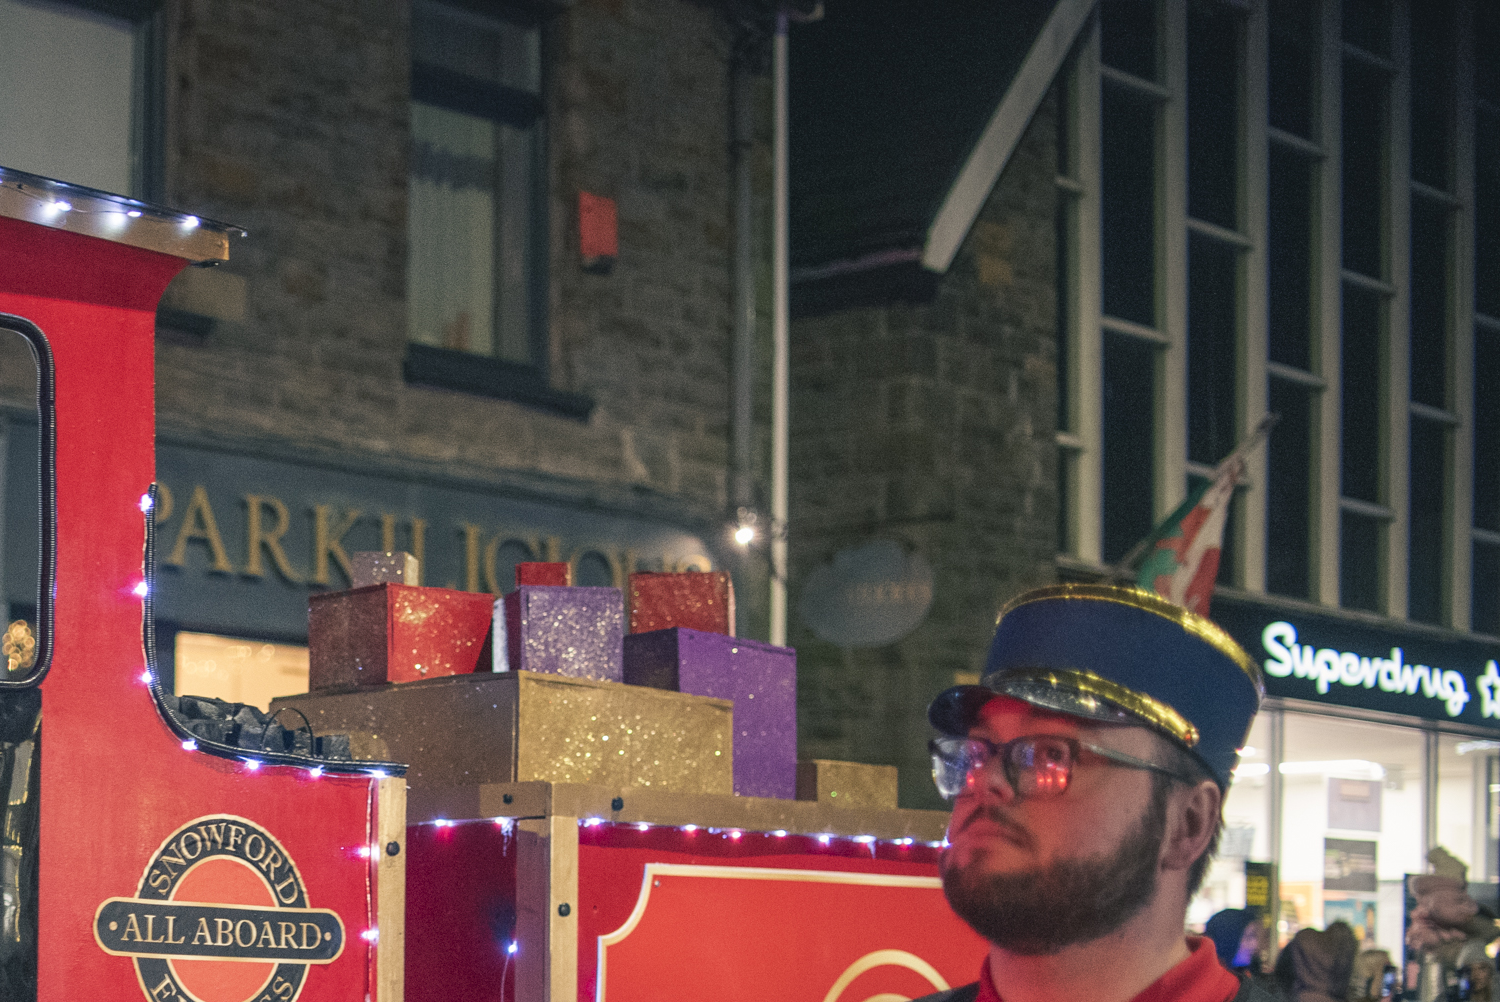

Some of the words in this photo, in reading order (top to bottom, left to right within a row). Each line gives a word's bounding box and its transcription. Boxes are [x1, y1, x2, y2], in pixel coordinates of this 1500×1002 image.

[1261, 621, 1471, 717] Superdrug
[150, 822, 299, 905] SNOWFORD
[121, 913, 185, 944] ALL
[191, 917, 322, 949] ABOARD
